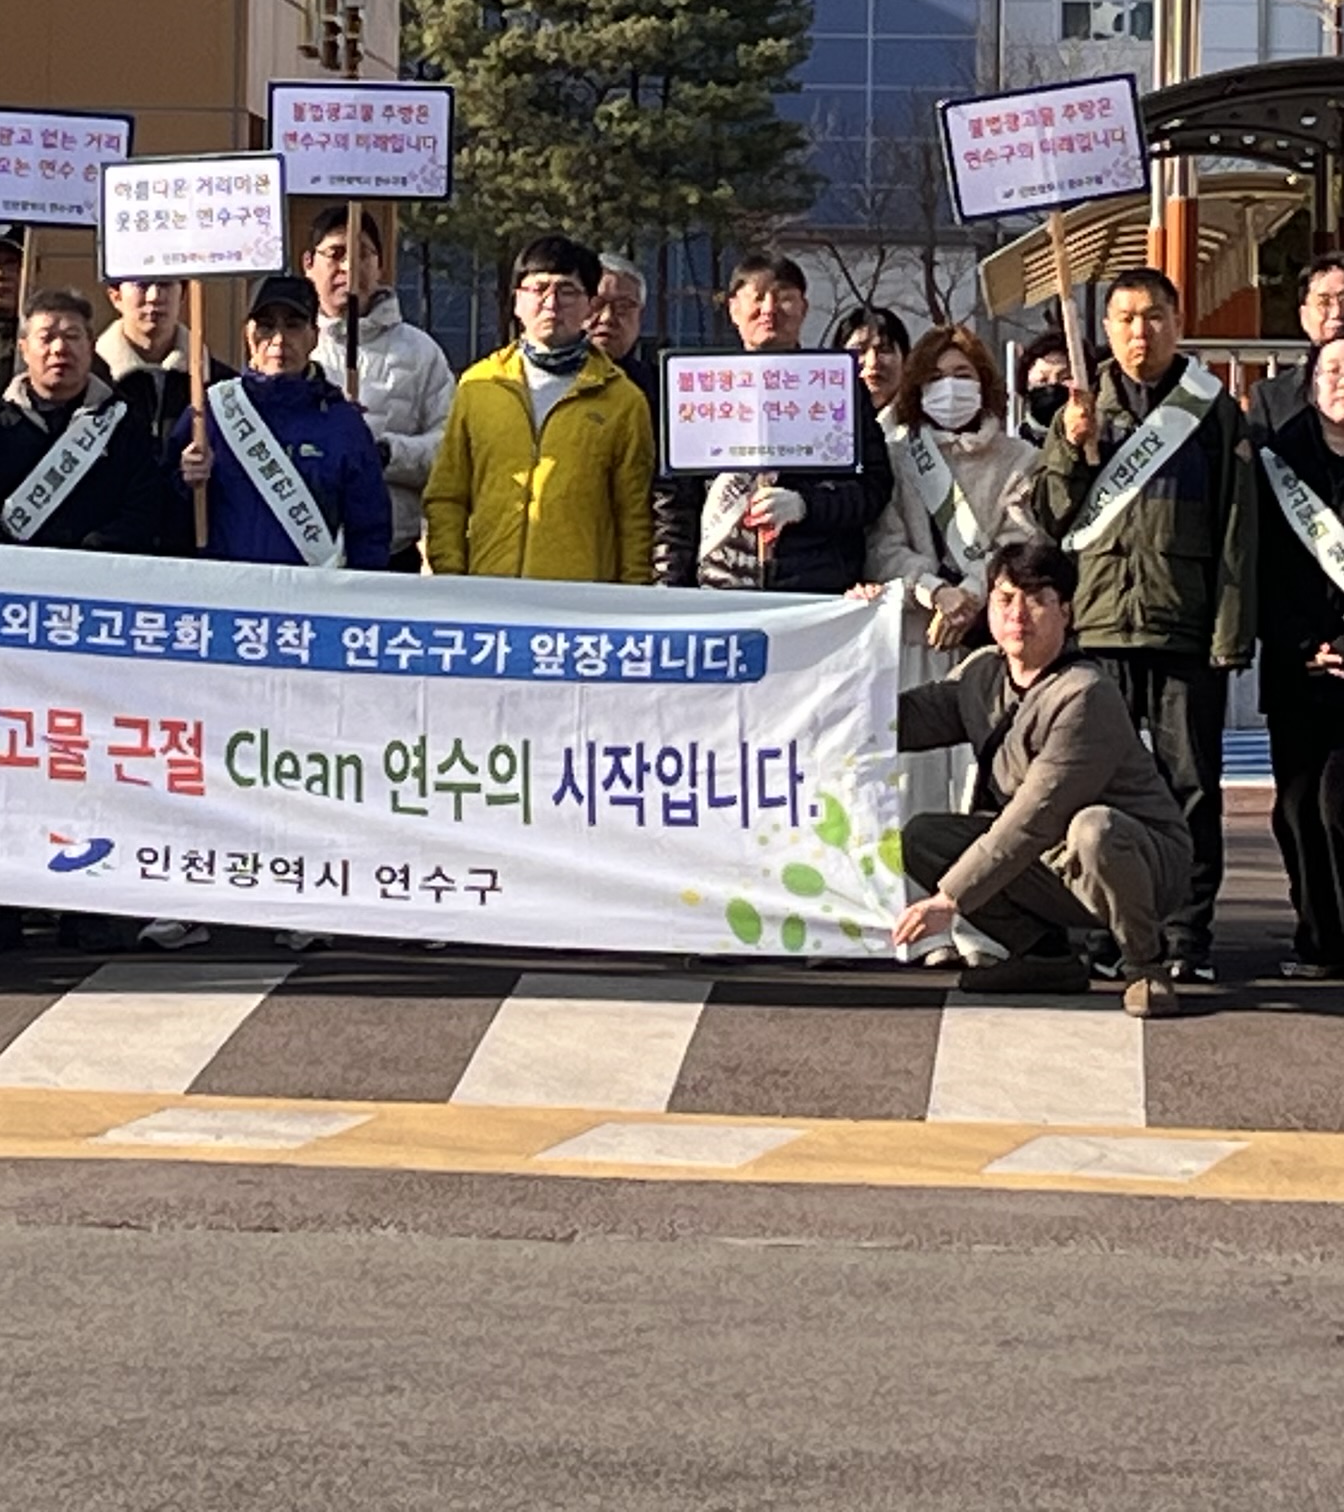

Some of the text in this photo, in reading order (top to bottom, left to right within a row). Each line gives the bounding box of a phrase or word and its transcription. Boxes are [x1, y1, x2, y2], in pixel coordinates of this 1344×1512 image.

[42, 129, 76, 150] 없는
[85, 132, 121, 152] 거리
[283, 131, 349, 152] 연수구의
[963, 142, 1034, 171] 연수구의
[39, 160, 74, 179] 연수
[115, 178, 186, 200] 아름다운
[678, 369, 846, 392] 불법광고 없는 거리
[678, 400, 846, 423] 찾아오는 연수 손님
[233, 616, 316, 665] 정착
[342, 625, 511, 674] 연수구가
[531, 632, 748, 680] 앞장섭니다.
[107, 714, 206, 798] 근절
[224, 726, 365, 804] Clean
[383, 734, 532, 826] 연수의
[553, 739, 820, 830] 시작입니다.
[136, 842, 503, 907] 인천광역시 연수구
